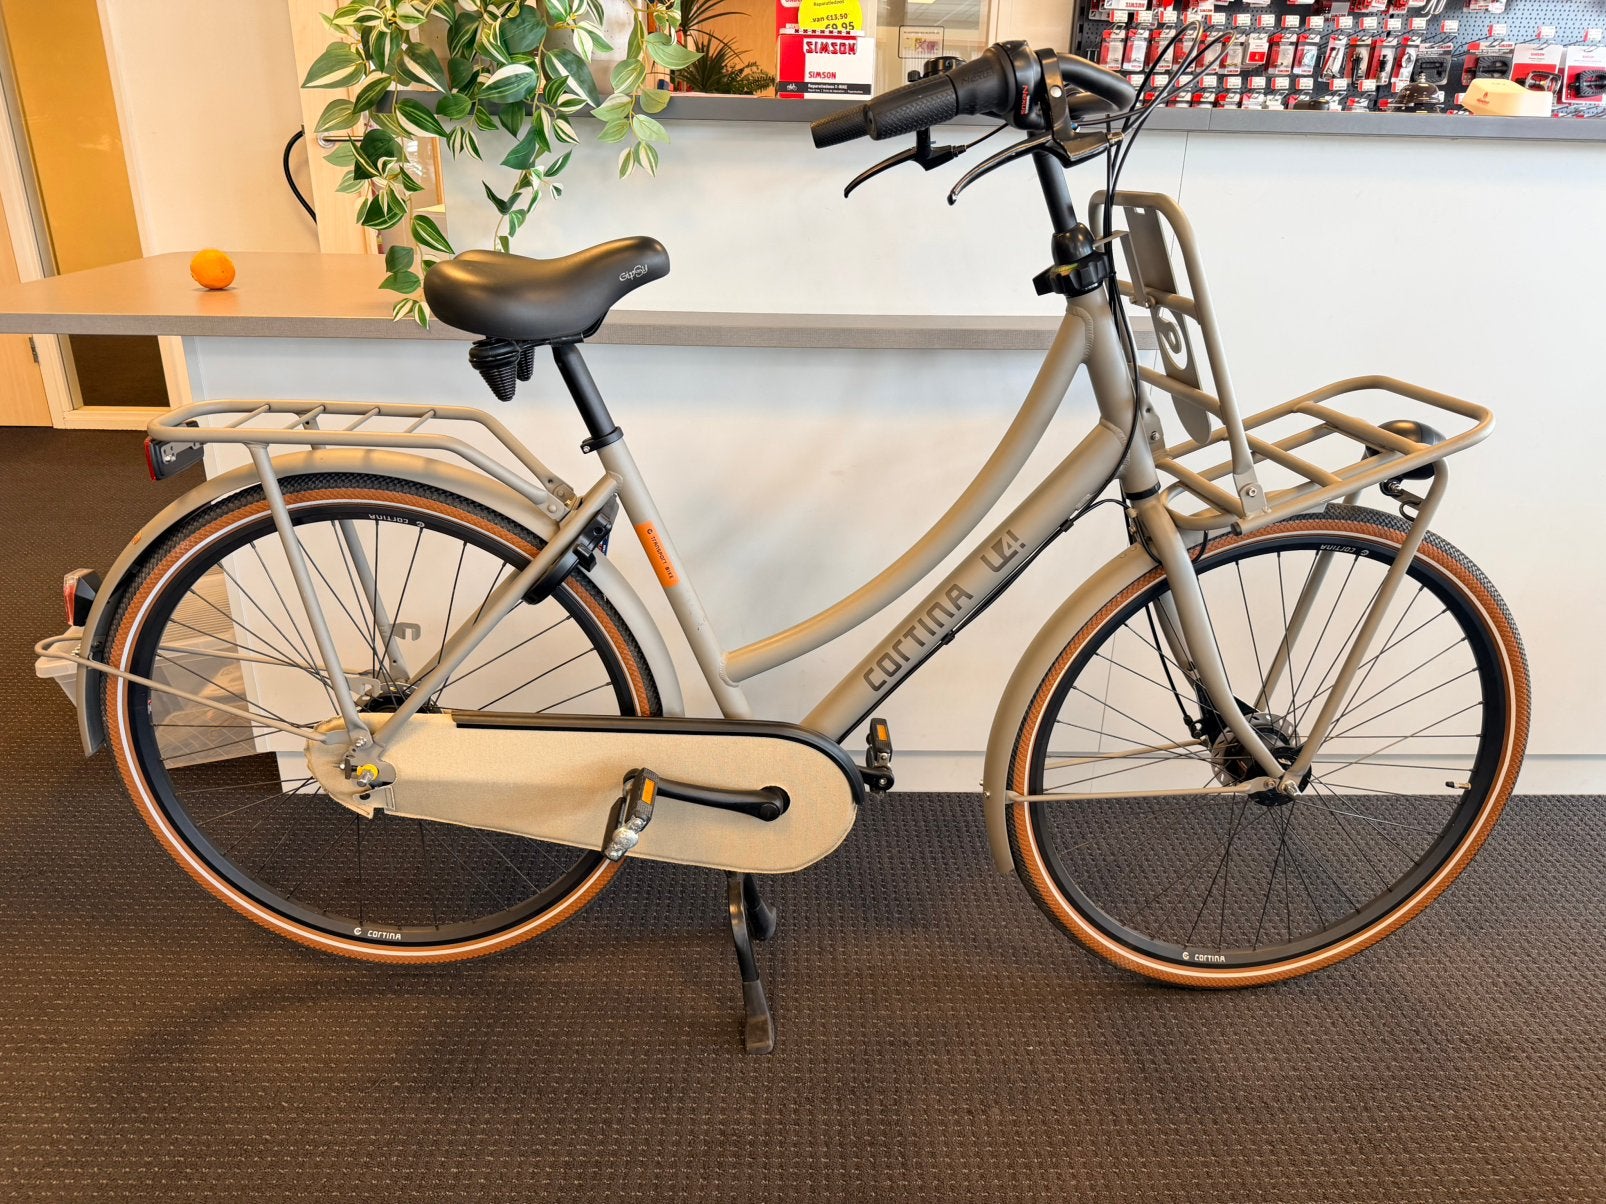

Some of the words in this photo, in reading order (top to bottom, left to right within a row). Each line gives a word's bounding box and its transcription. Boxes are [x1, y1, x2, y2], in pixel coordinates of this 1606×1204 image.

[825, 21, 855, 30] €995
[805, 41, 856, 55] SIMSON
[808, 71, 837, 79] SIMSON
